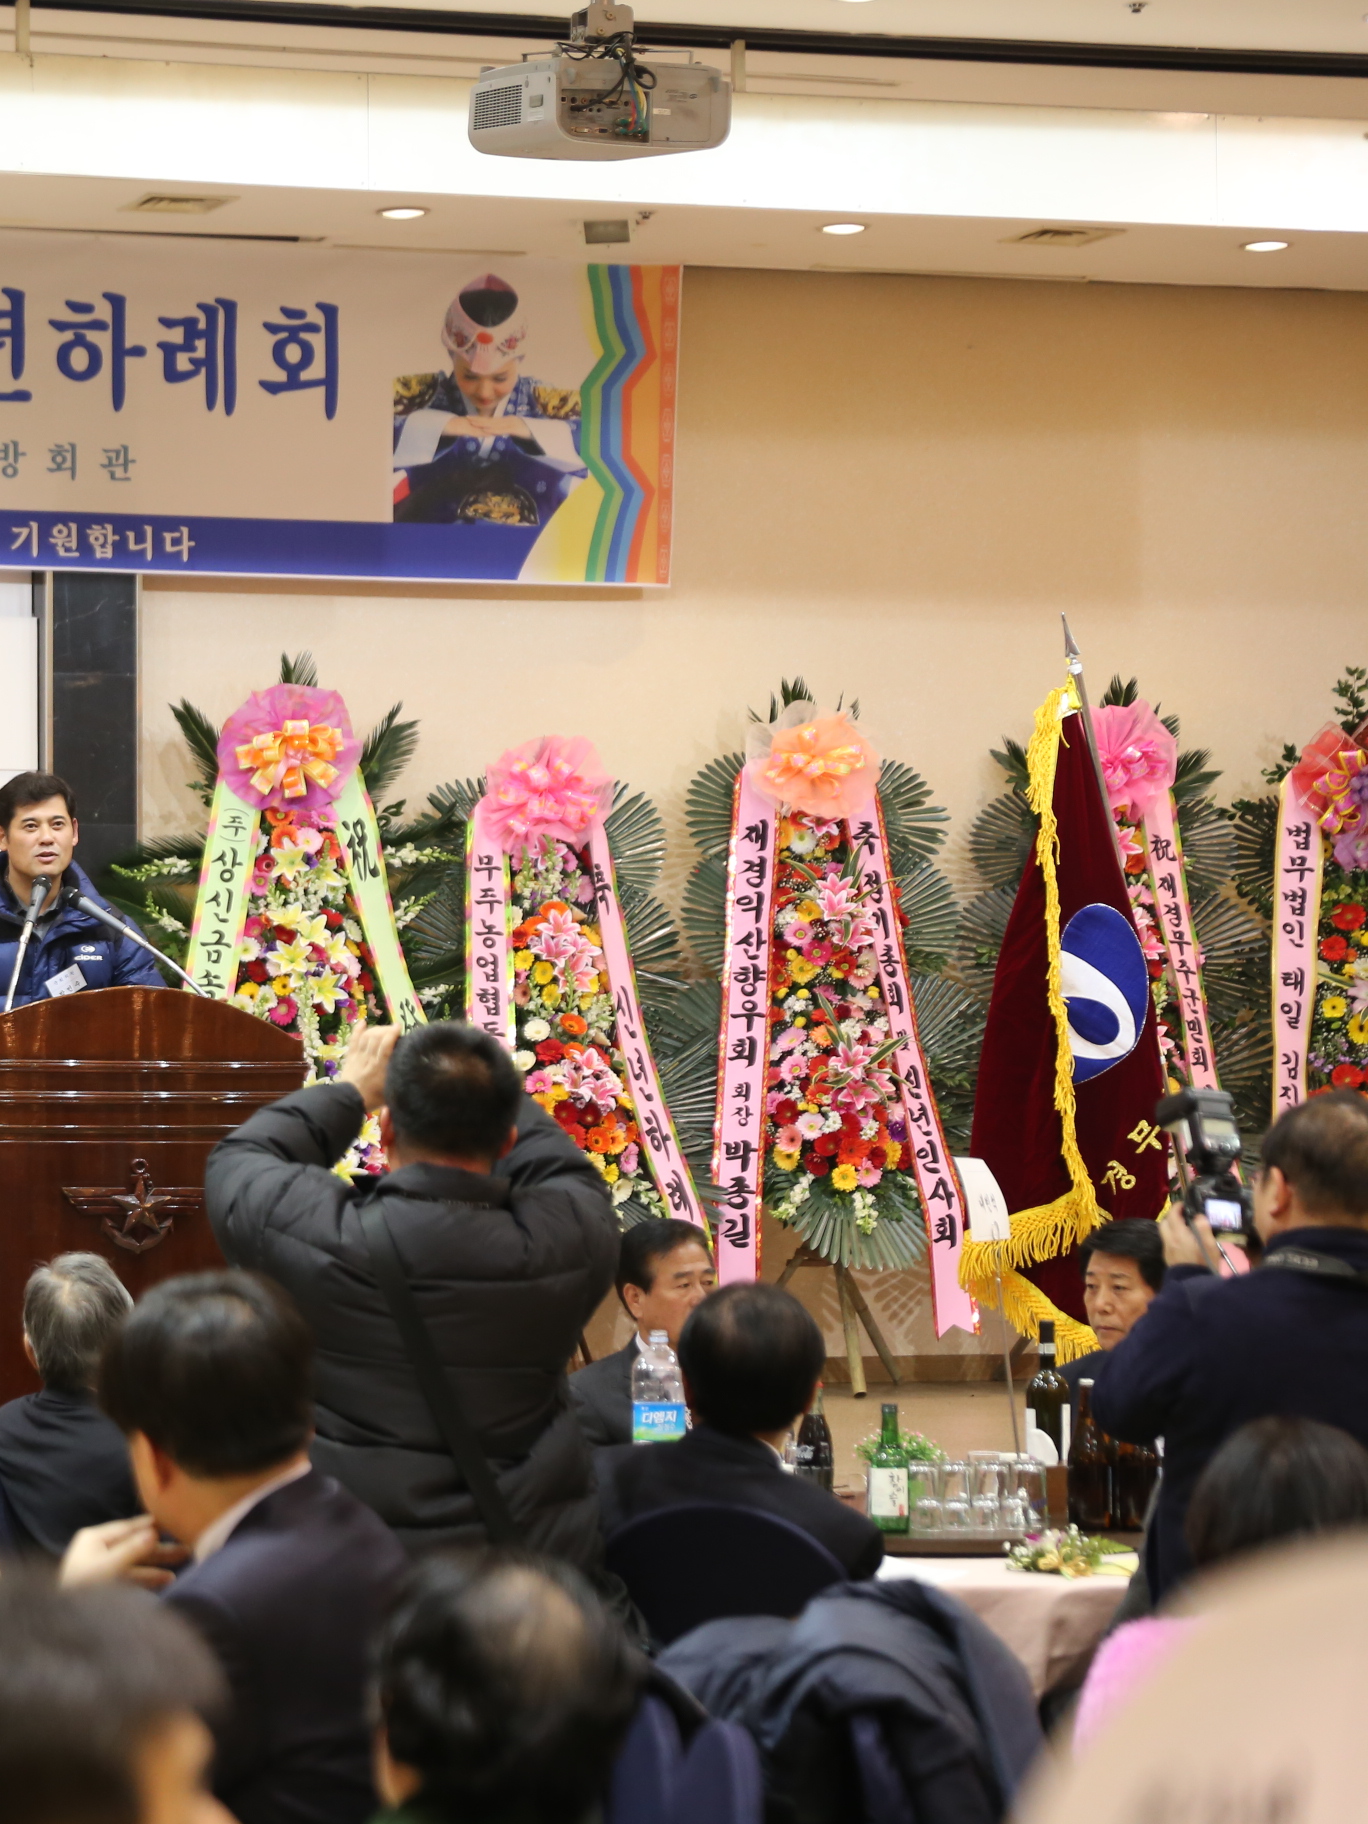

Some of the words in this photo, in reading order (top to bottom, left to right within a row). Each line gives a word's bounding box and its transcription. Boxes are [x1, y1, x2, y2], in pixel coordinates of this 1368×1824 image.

[10, 518, 196, 562] 기원합니다
[342, 818, 380, 882] 祝
[852, 821, 879, 856] 축
[1150, 834, 1177, 862] 祝
[1283, 821, 1315, 948] 법무법인
[729, 820, 769, 1070] 재경익산향우회
[863, 870, 904, 1015] 정기총회
[1156, 872, 1208, 1073] 재경무주군민회
[1280, 967, 1306, 1030] 태일
[730, 1082, 754, 1128] 회장
[903, 1065, 958, 1250] 신년인사회
[720, 1140, 759, 1250] 박종길
[642, 1410, 677, 1424] 디엠지
